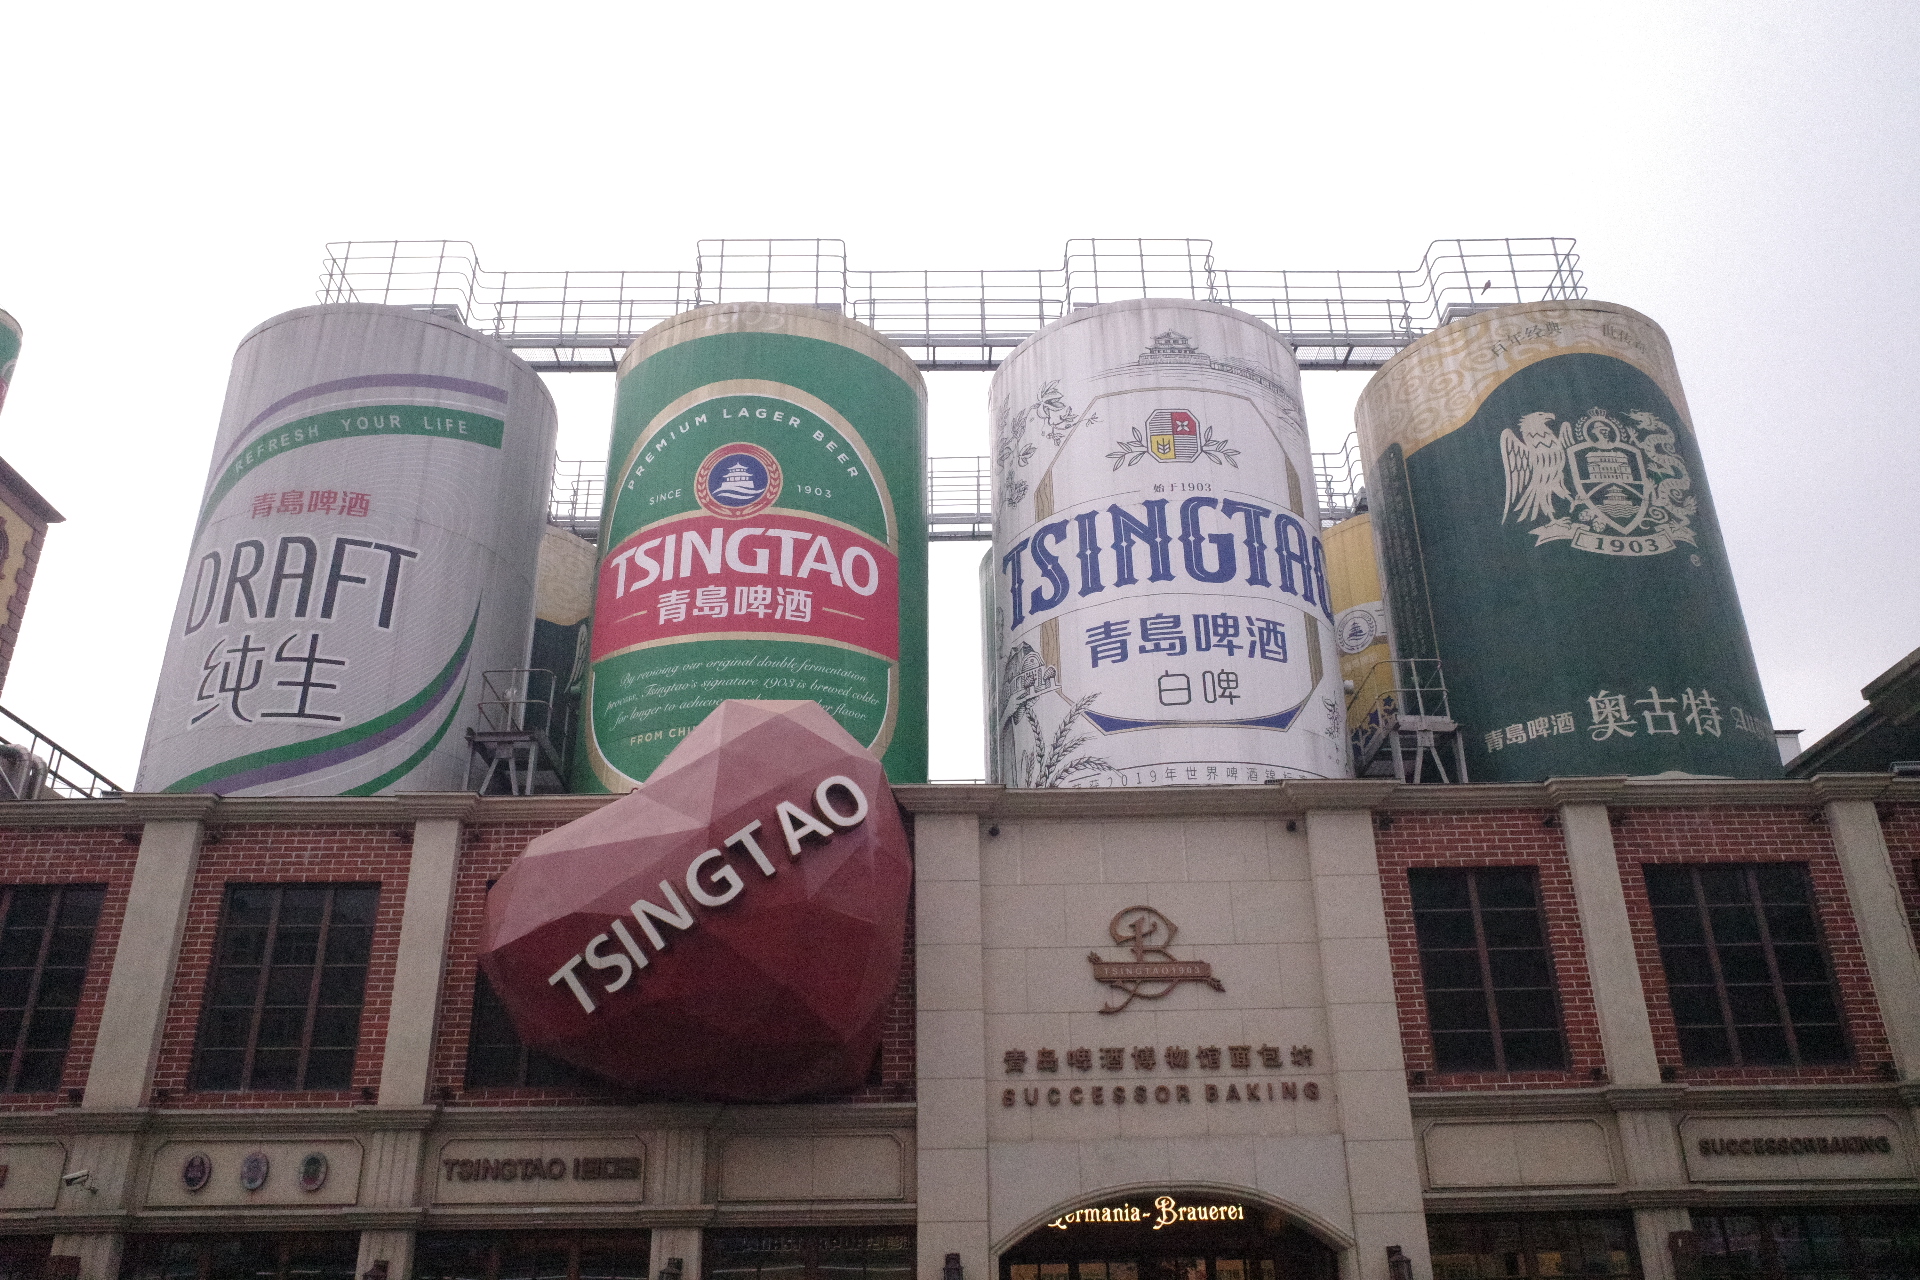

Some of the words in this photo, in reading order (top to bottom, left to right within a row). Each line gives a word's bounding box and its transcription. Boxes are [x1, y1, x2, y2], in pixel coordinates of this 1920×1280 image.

[234, 424, 320, 474] REFRESH
[340, 414, 402, 432] YOUR
[422, 416, 469, 435] LIFE
[627, 413, 708, 491] PREMIUM
[722, 406, 801, 429] LAGER
[812, 429, 860, 479] BEER
[648, 487, 683, 506] SINCE
[796, 483, 833, 499] 1903
[609, 527, 879, 600] TSINGTAO
[1002, 496, 1336, 631] TSINGTAO
[1594, 537, 1660, 554] 1903
[183, 535, 419, 637] DRAFT
[656, 584, 814, 626] 青島啤酒
[1084, 612, 1290, 669] 青島啤酒
[190, 632, 346, 726] 纯生
[682, 662, 705, 671] our
[705, 655, 758, 671] original
[756, 655, 798, 671] double
[791, 659, 868, 683] fermentation
[1157, 668, 1241, 707] 白啤
[701, 676, 759, 691] signature
[763, 676, 795, 689] 1903
[797, 679, 807, 690] is
[810, 679, 853, 697] brewed
[852, 691, 880, 706] colder
[608, 711, 630, 731] for
[630, 706, 662, 721] longer
[664, 704, 676, 712] to
[1483, 710, 1577, 753] 青島啤酒
[1586, 685, 1724, 742] 奥古特
[629, 730, 663, 747] FROM
[547, 774, 869, 1015] TSINGTAO
[1002, 1084, 1191, 1108] SUCCESSOR
[1204, 1081, 1320, 1102] BAKING
[443, 1157, 567, 1182] TSINGTAO
